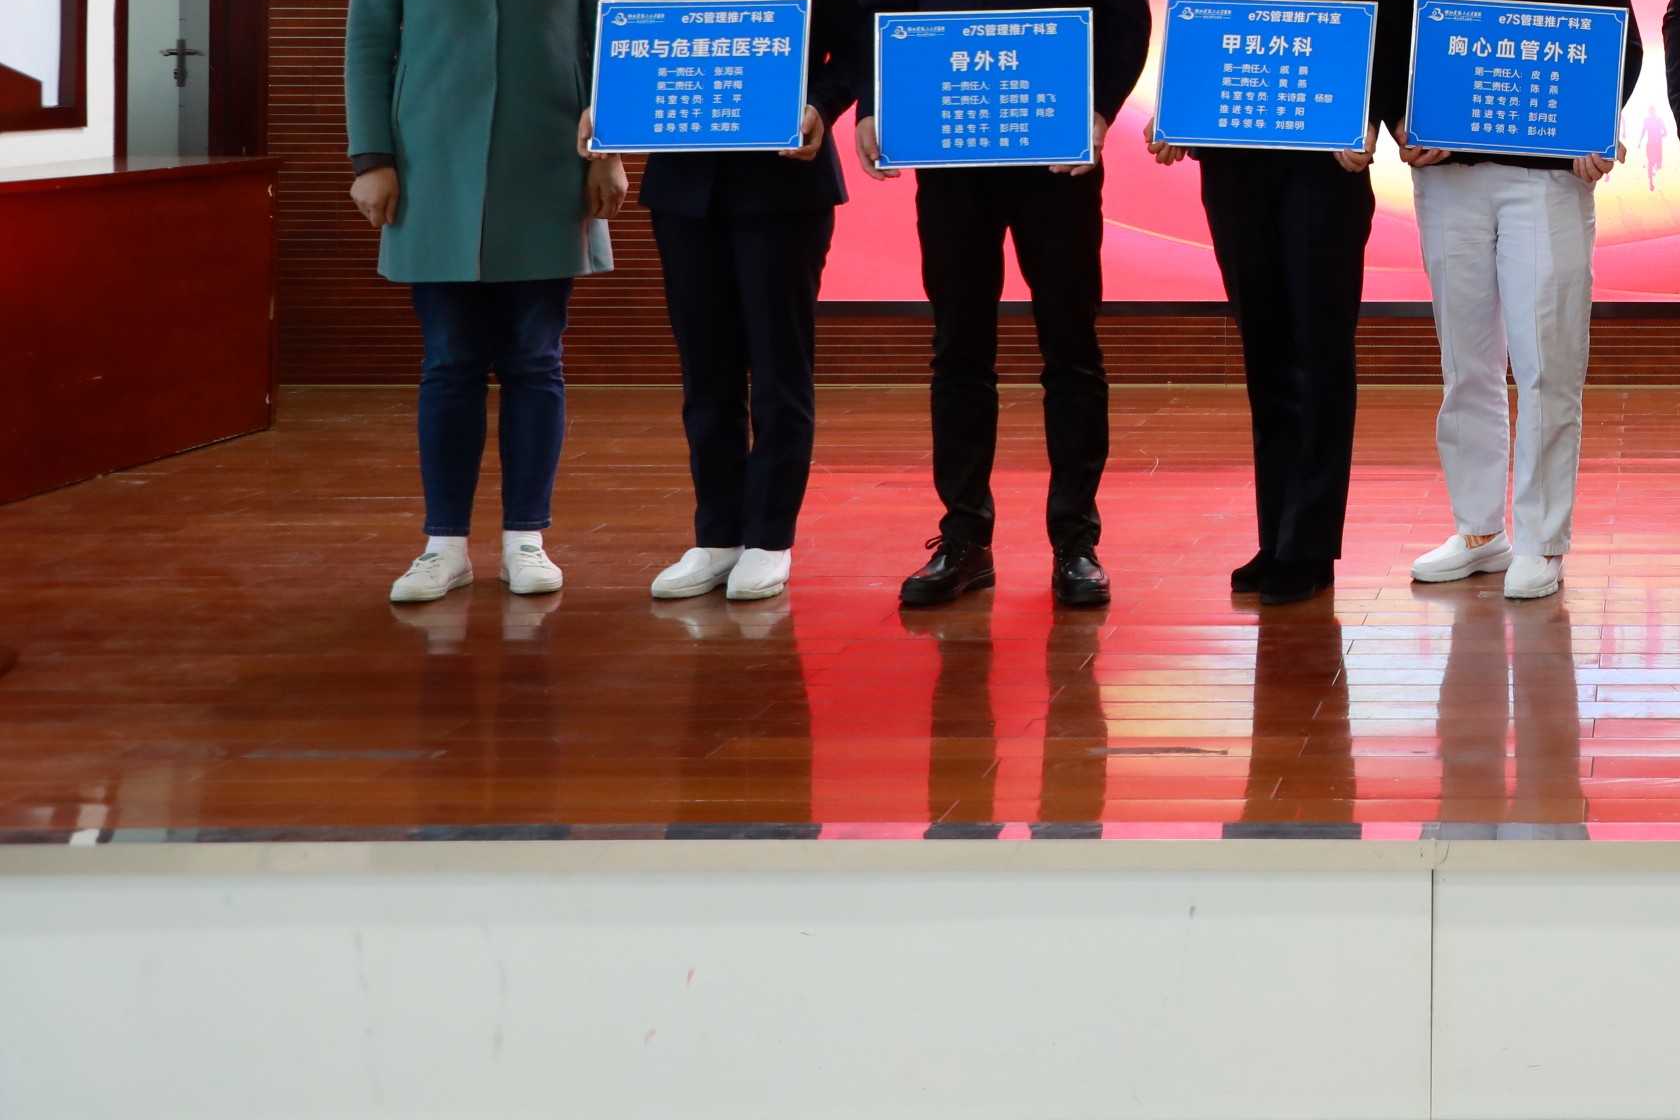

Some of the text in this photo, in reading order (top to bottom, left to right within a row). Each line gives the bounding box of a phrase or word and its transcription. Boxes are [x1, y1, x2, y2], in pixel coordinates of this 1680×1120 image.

[682, 12, 775, 24] e7S管理推广科室
[1248, 11, 1341, 24] e7S管理推广科室
[1499, 14, 1592, 30] e7S管理推广科室
[963, 24, 1057, 37] e7S管理推广科室
[611, 38, 791, 58] 呼吸与危重症医学科
[1222, 34, 1312, 56] 甲乳外科
[1448, 36, 1587, 64] 胸心血管外科
[950, 50, 1019, 72] 骨外科
[713, 95, 741, 103] 王平
[1036, 94, 1056, 103] 黄飞
[1277, 107, 1304, 116] 李阳
[1528, 112, 1557, 123] 彭月虹
